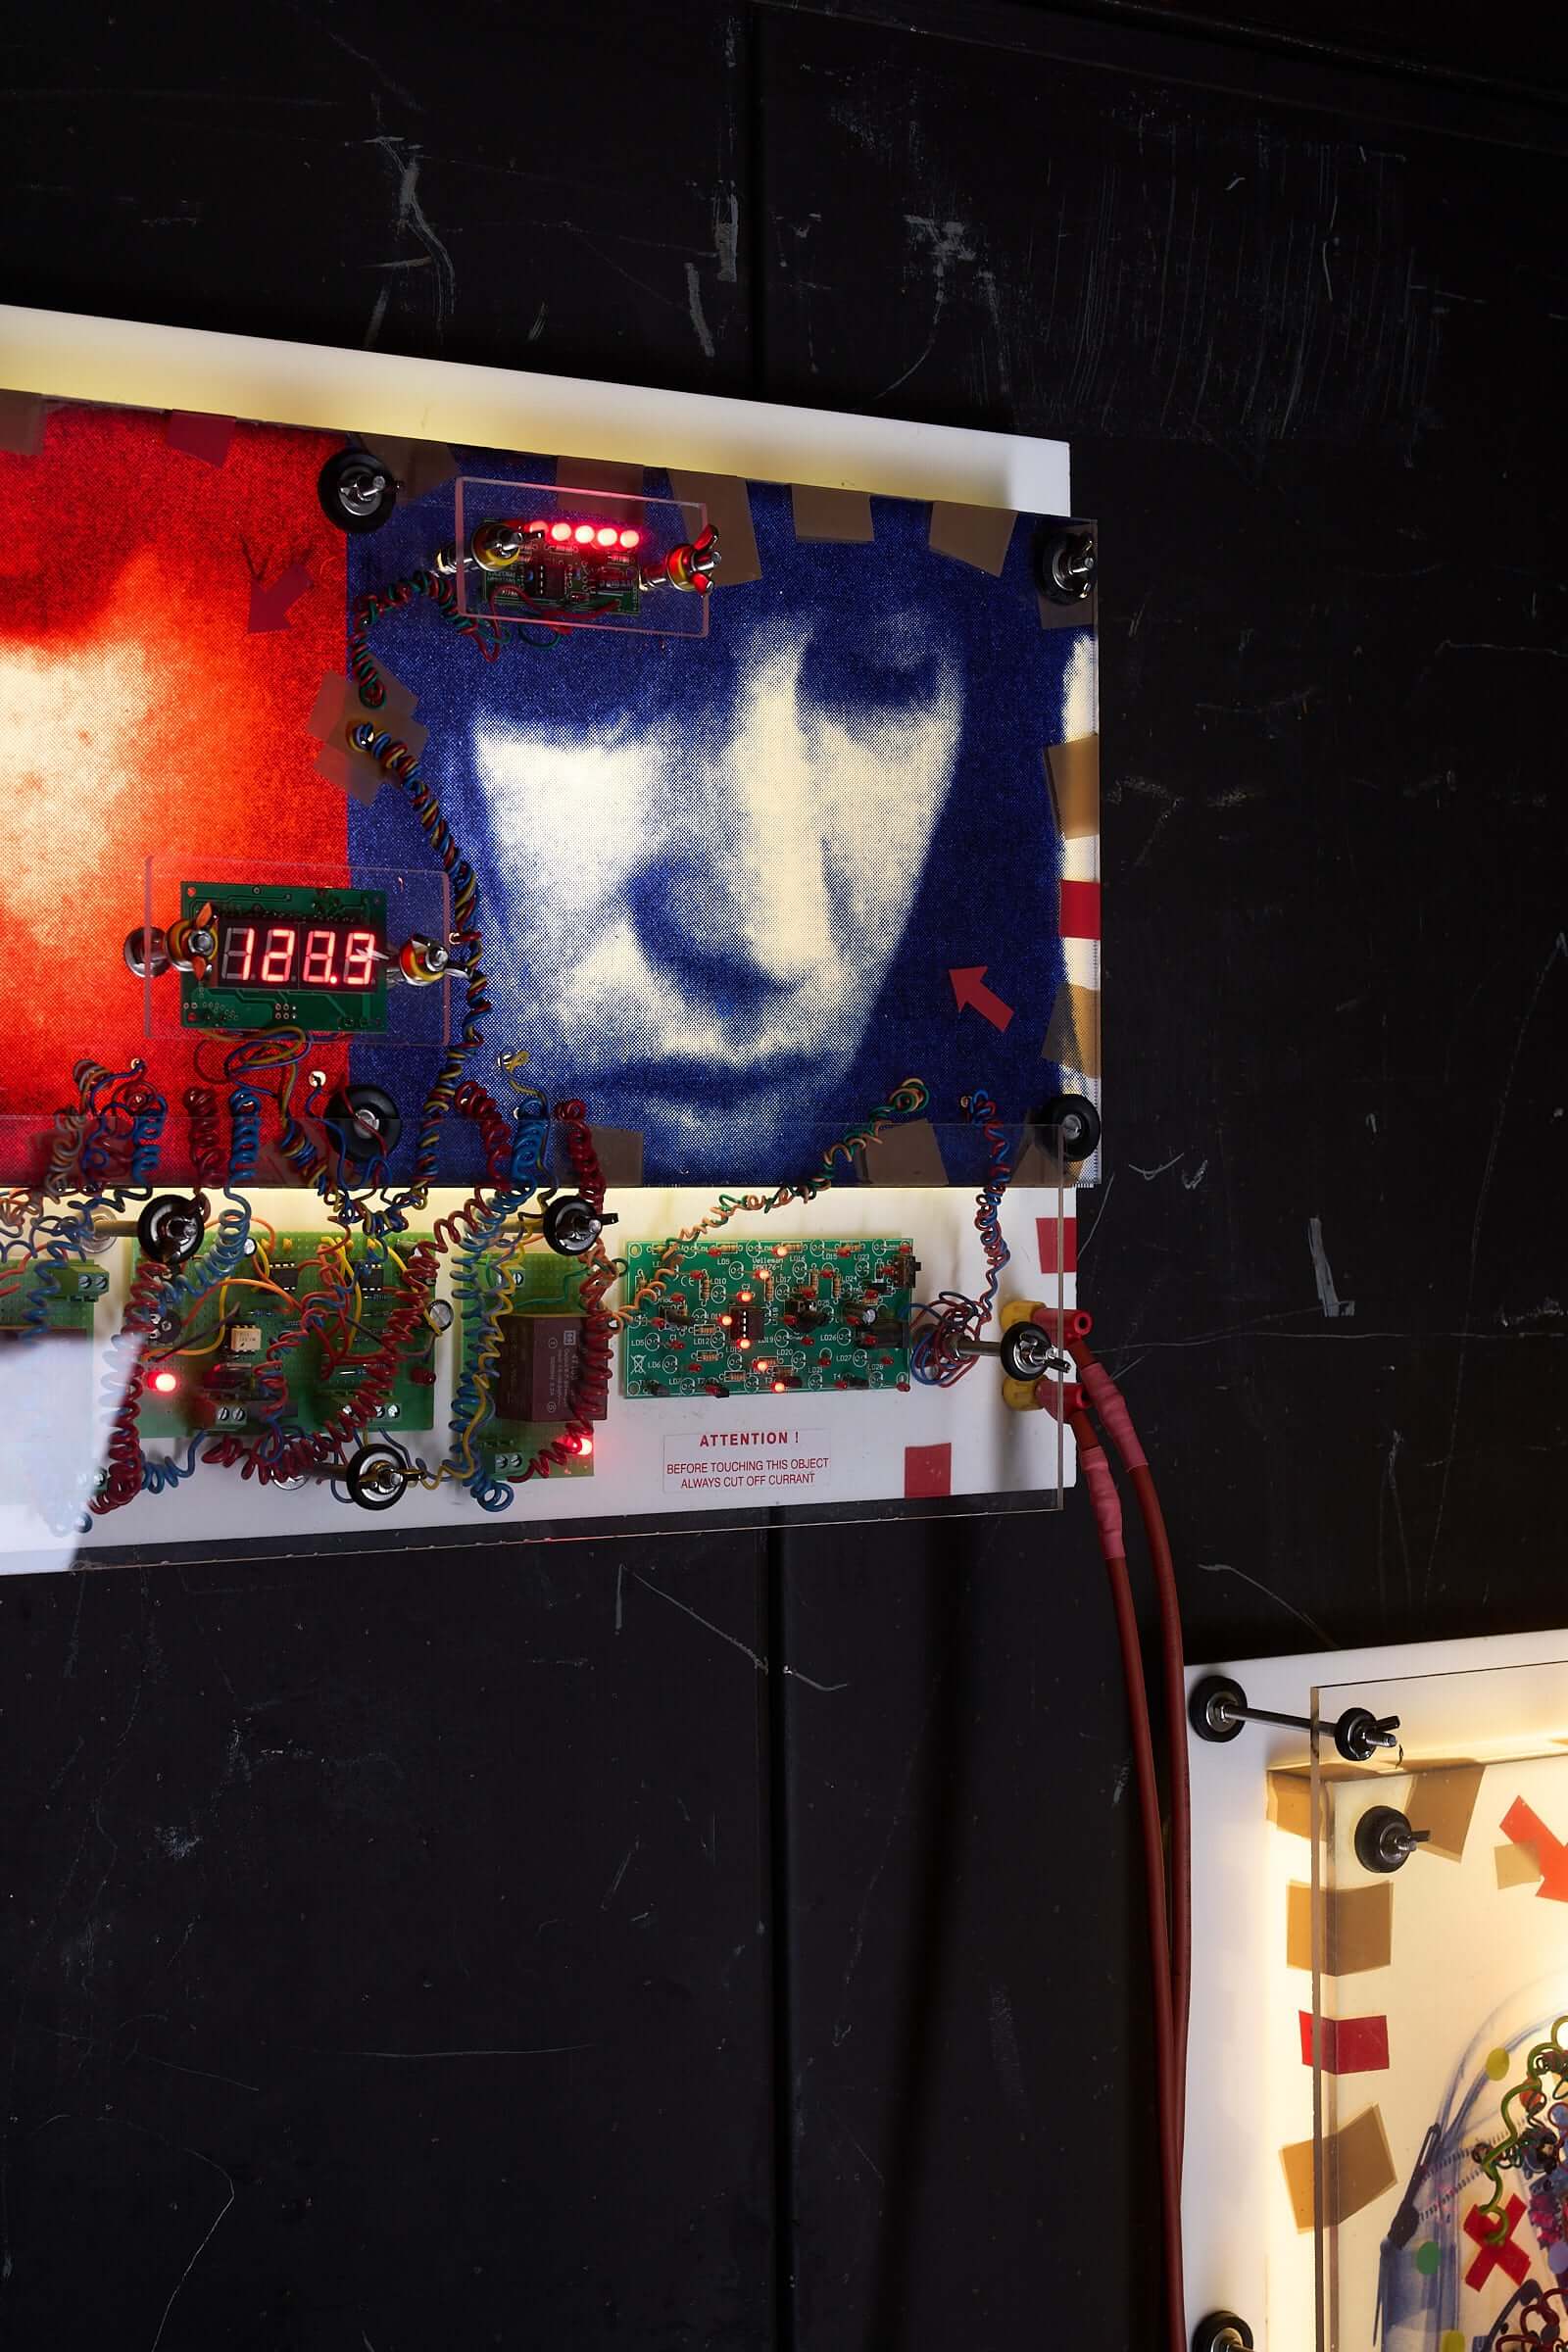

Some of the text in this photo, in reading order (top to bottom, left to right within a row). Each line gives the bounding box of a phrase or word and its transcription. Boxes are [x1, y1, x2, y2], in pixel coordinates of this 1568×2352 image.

[699, 1432, 788, 1446] ATTENTION
[666, 1457, 830, 1475] BEFORE TOUCHING THIS OBJECT
[680, 1472, 816, 1489] ALWAYS CUT OFF CURRANT
